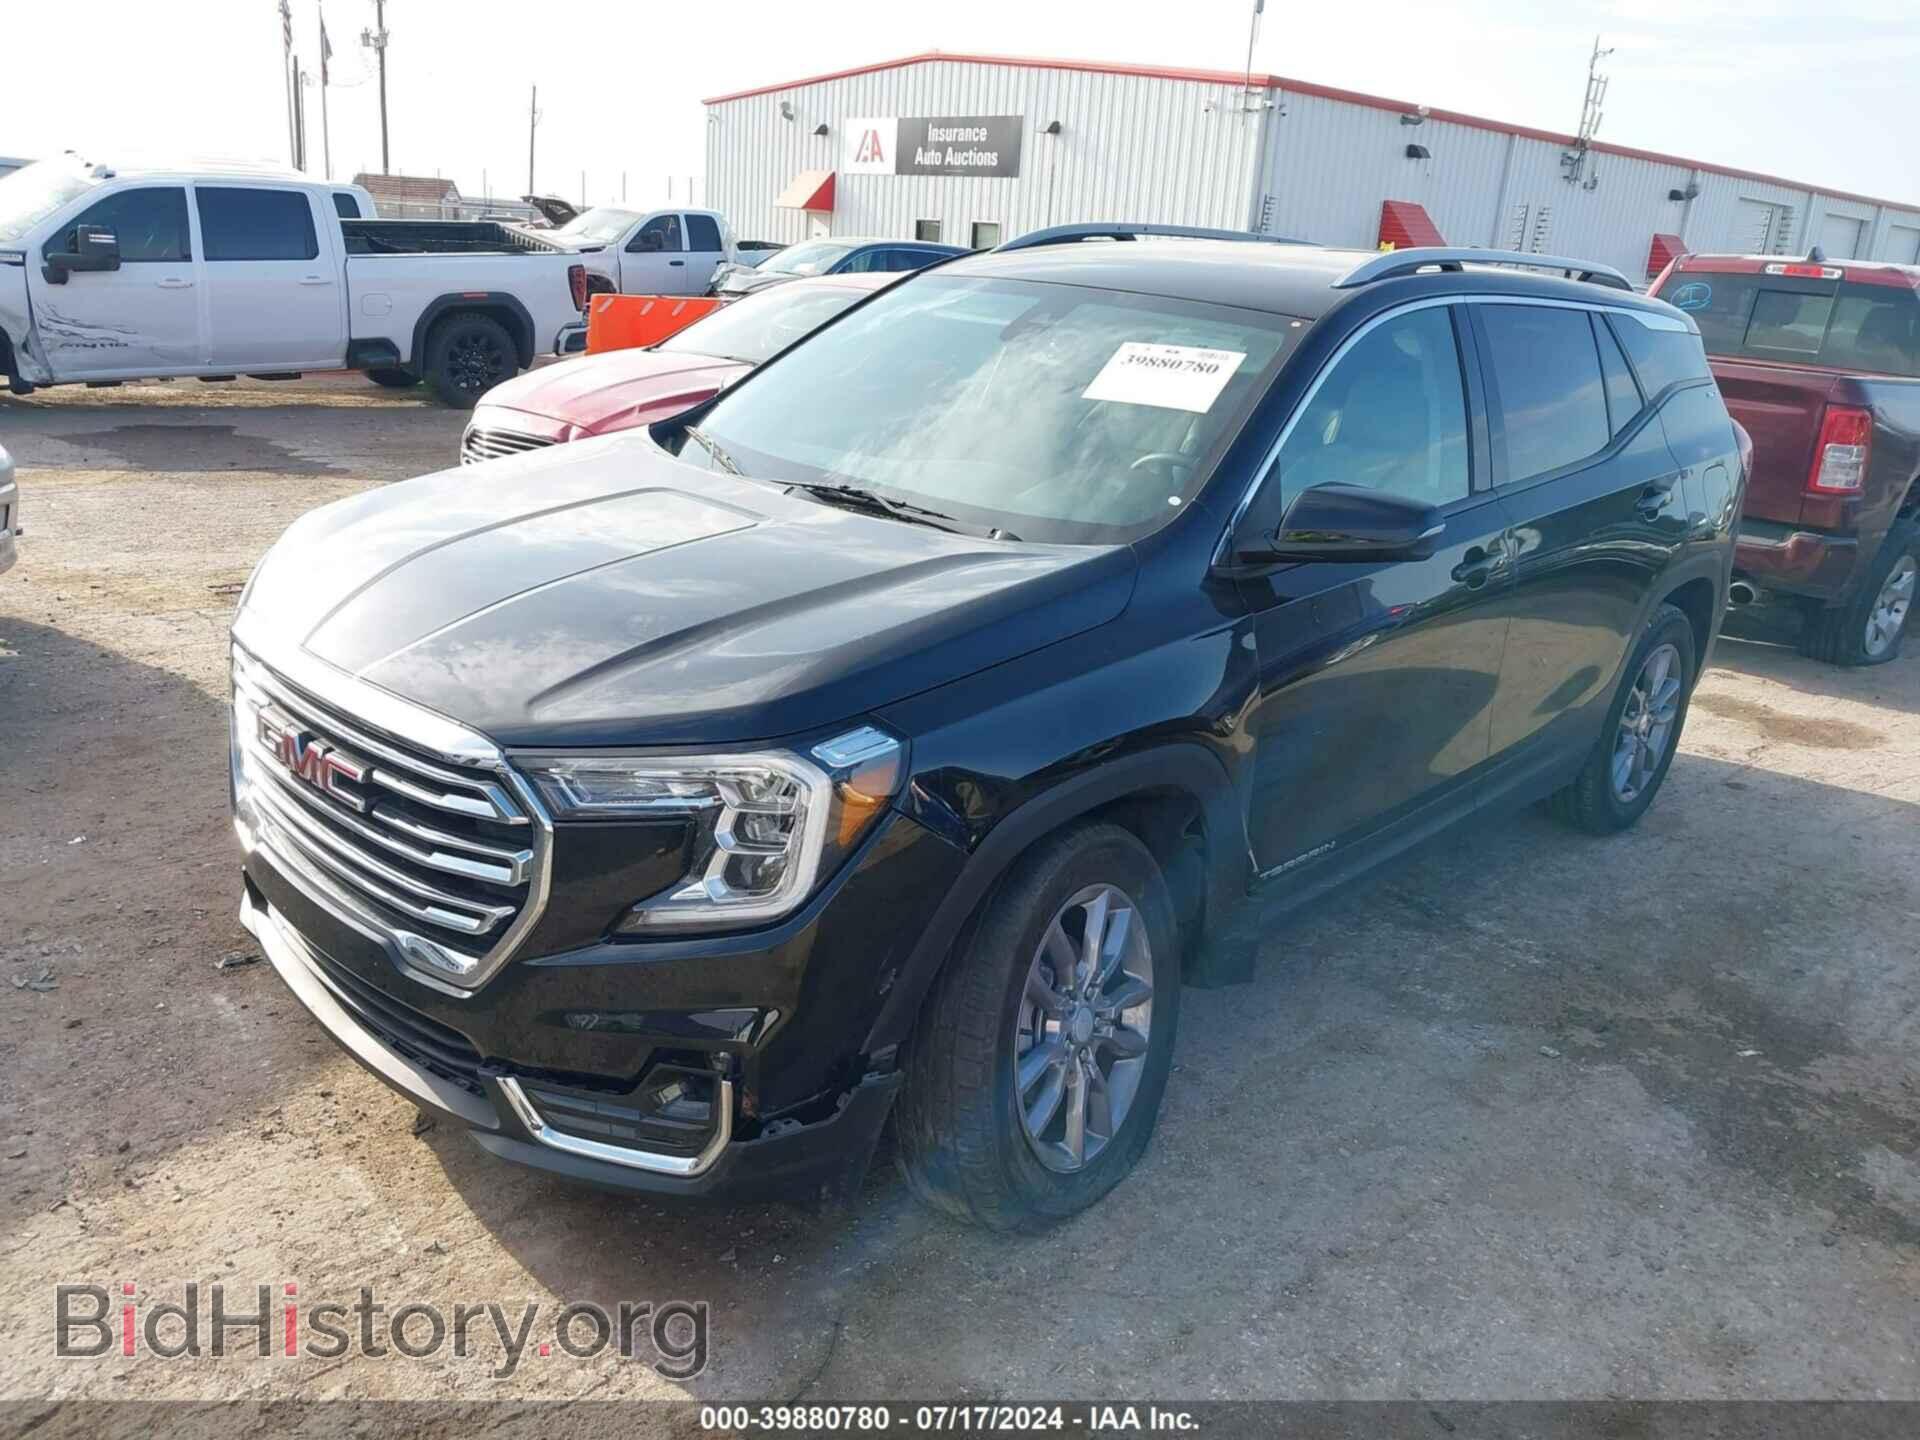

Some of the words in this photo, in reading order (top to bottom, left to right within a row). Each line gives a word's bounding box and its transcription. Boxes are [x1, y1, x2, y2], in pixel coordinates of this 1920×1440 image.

[927, 122, 988, 142] Insurance
[914, 146, 942, 166] Auto
[944, 146, 998, 167] Auctions
[1120, 353, 1220, 375] 39880780
[256, 706, 367, 814] GMC
